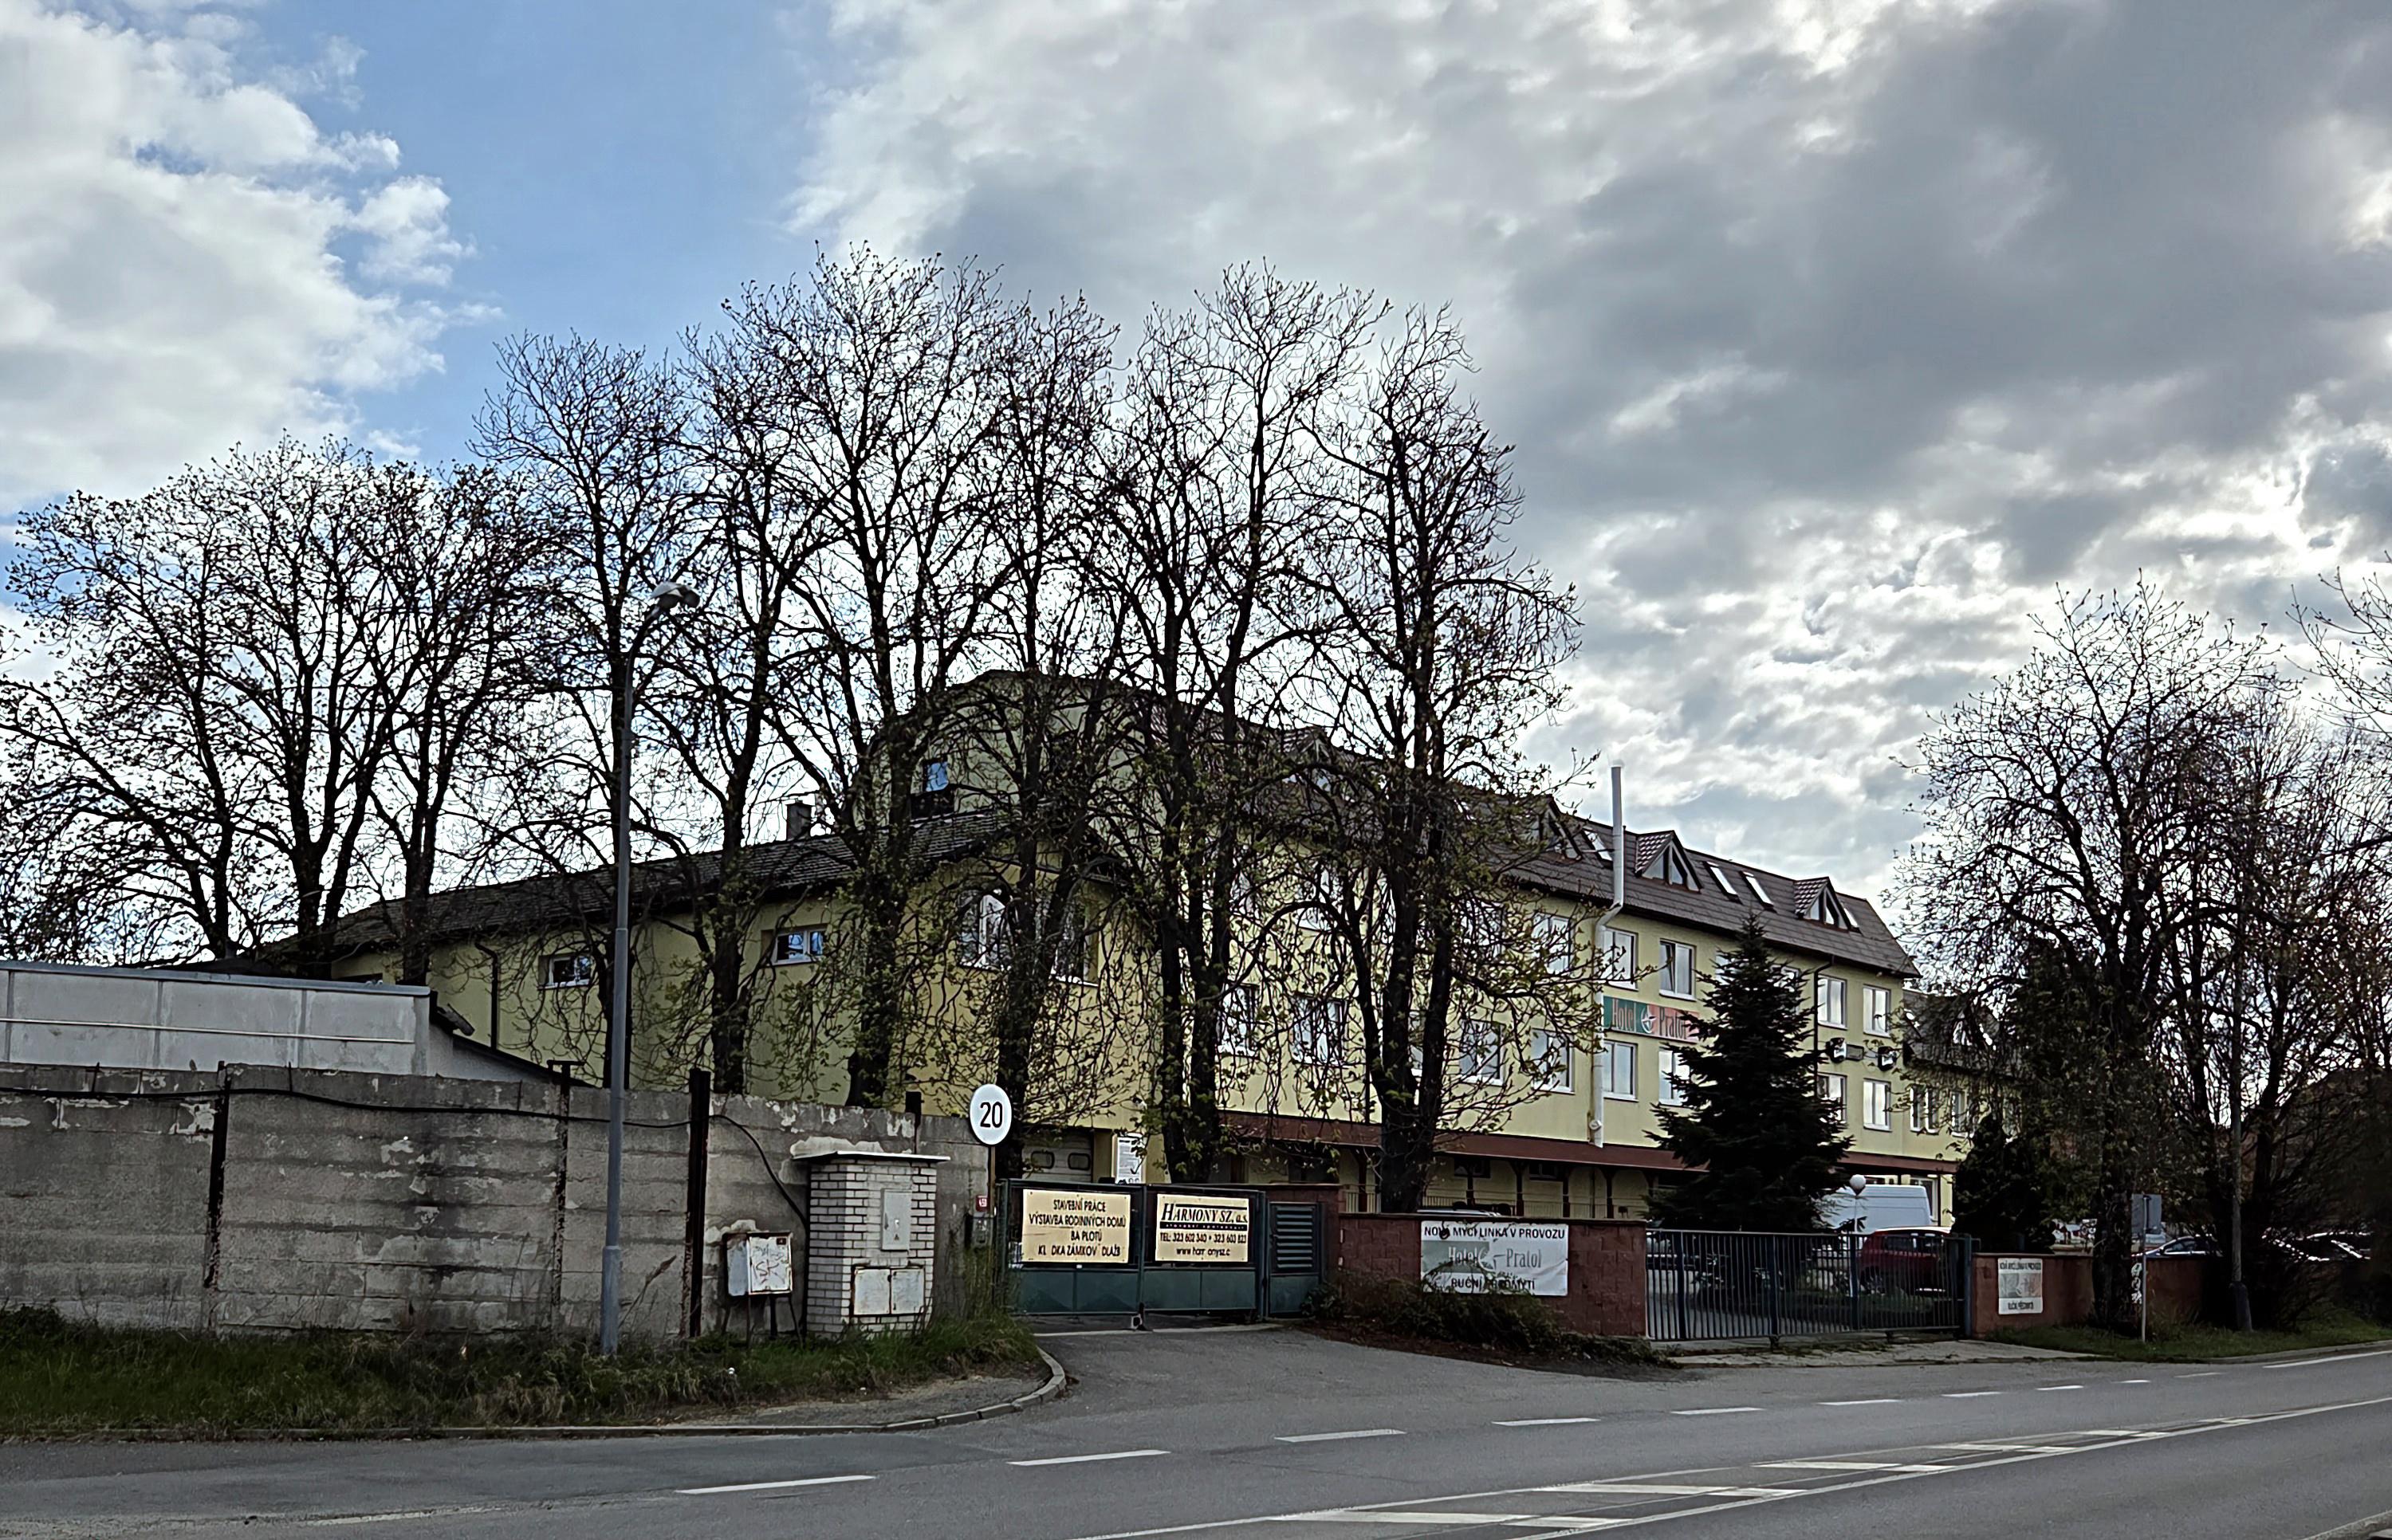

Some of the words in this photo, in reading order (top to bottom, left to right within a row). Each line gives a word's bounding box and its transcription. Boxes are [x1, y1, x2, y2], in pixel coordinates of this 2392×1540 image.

[1612, 998, 1636, 1032] Hotel
[980, 1102, 1003, 1129] 20
[1053, 1198, 1083, 1211] STAVEBNÍ
[1029, 1212, 1063, 1225] VÝSTAVBA
[1065, 1213, 1105, 1226] RODINNÝCH
[1161, 1203, 1218, 1221] HARMONY
[1172, 1232, 1184, 1242] 323
[1214, 1234, 1225, 1243] 323
[1479, 1227, 1509, 1237] LINKA
[1509, 1228, 1517, 1236] V
[1518, 1228, 1565, 1239] PROVOZU
